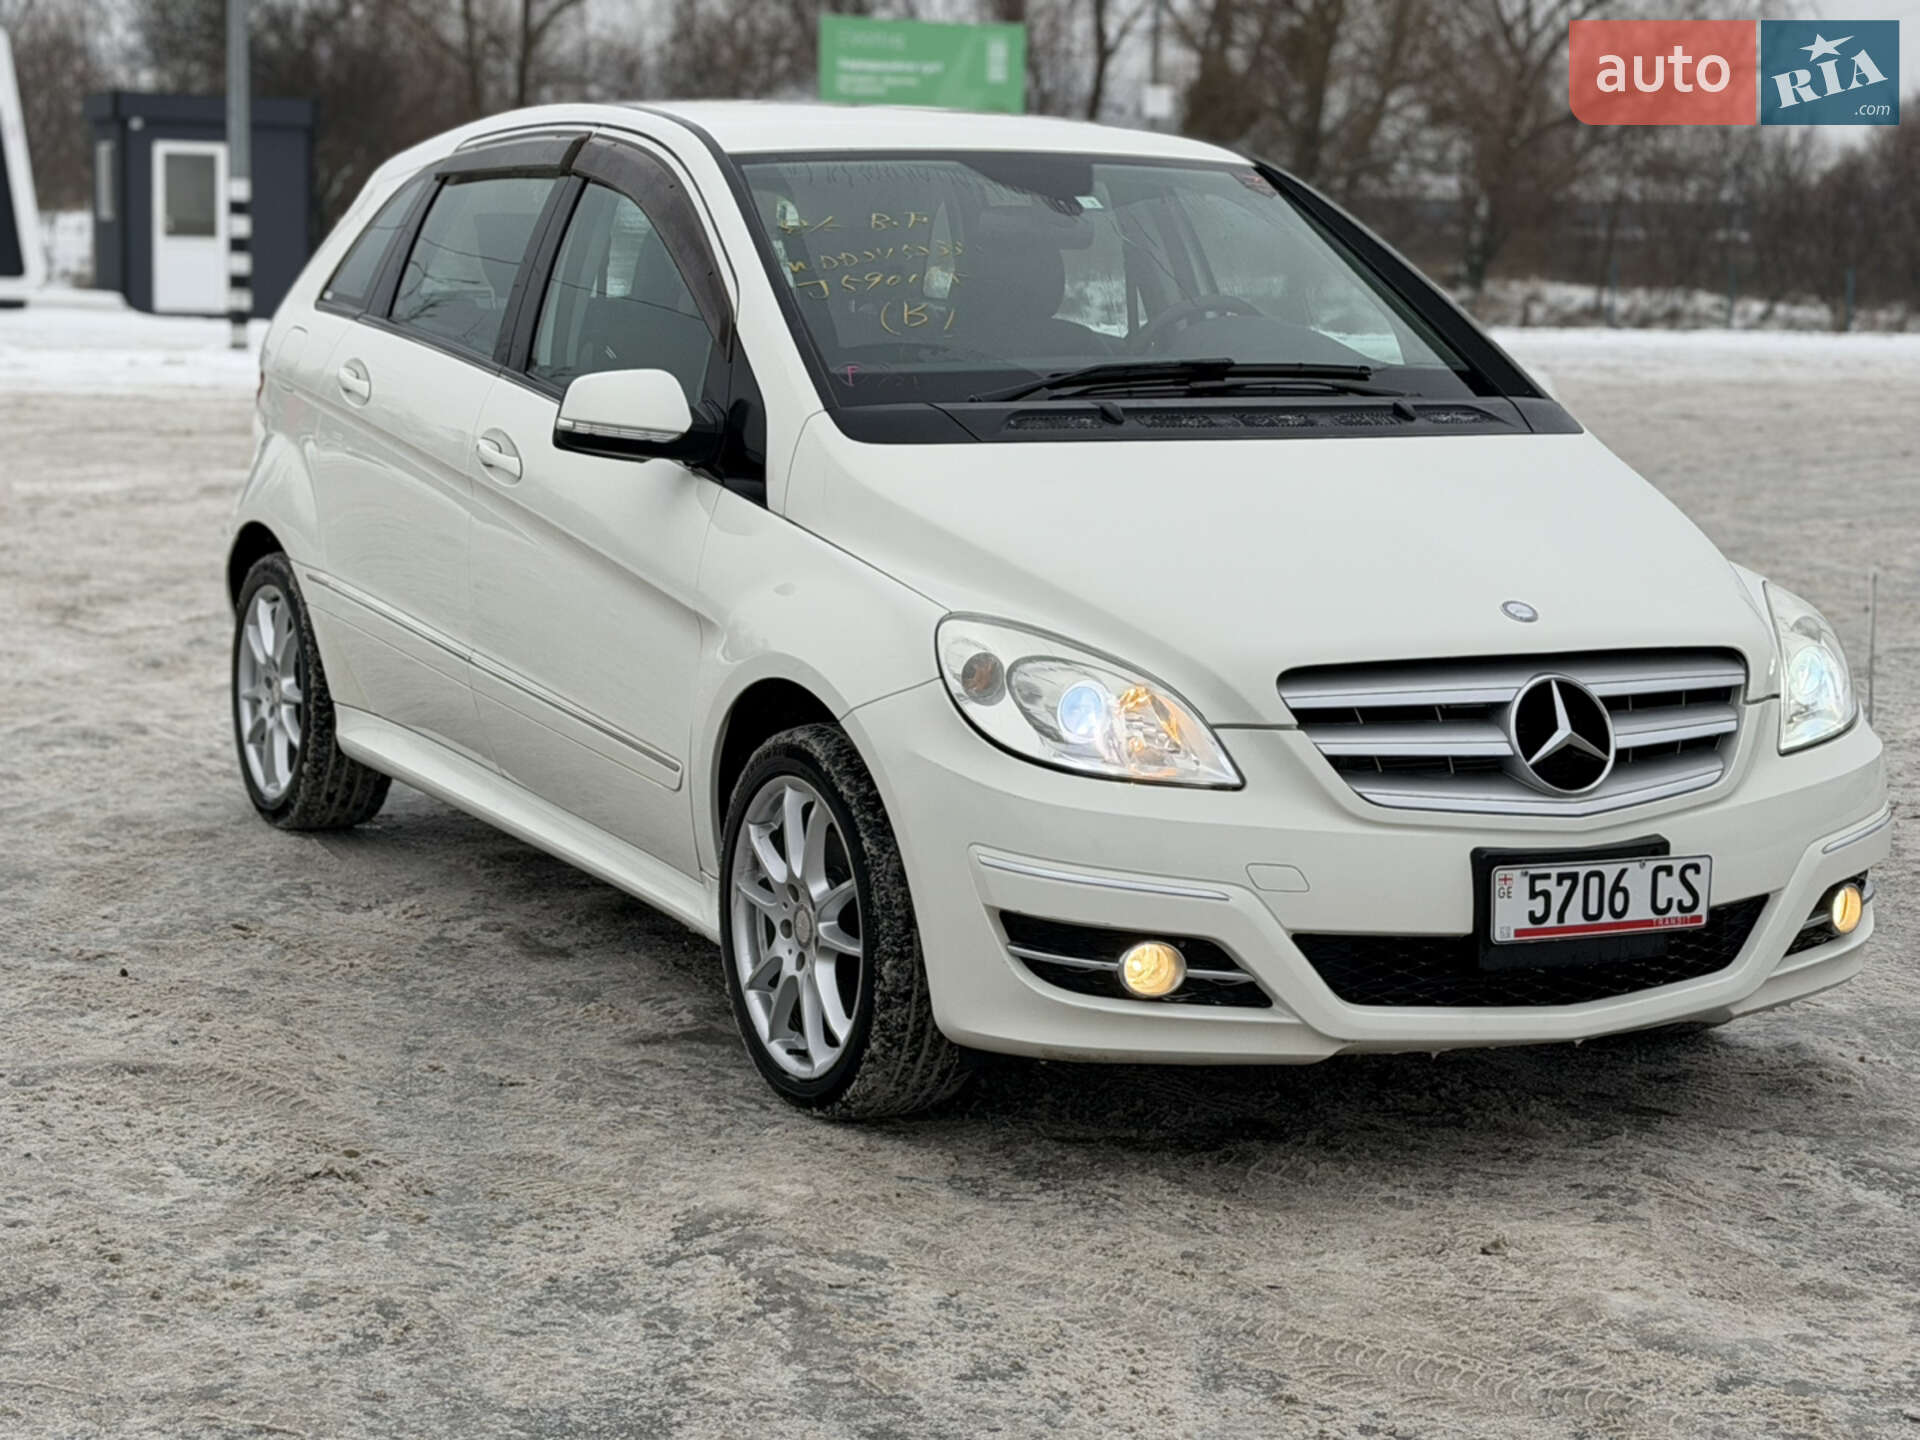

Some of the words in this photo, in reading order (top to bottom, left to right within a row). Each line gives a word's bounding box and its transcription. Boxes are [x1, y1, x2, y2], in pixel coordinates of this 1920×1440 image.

[1497, 886, 1513, 899] GE
[1527, 867, 1630, 926] 5706
[1650, 862, 1701, 916] CS
[1653, 915, 1691, 927] TRANSIT
